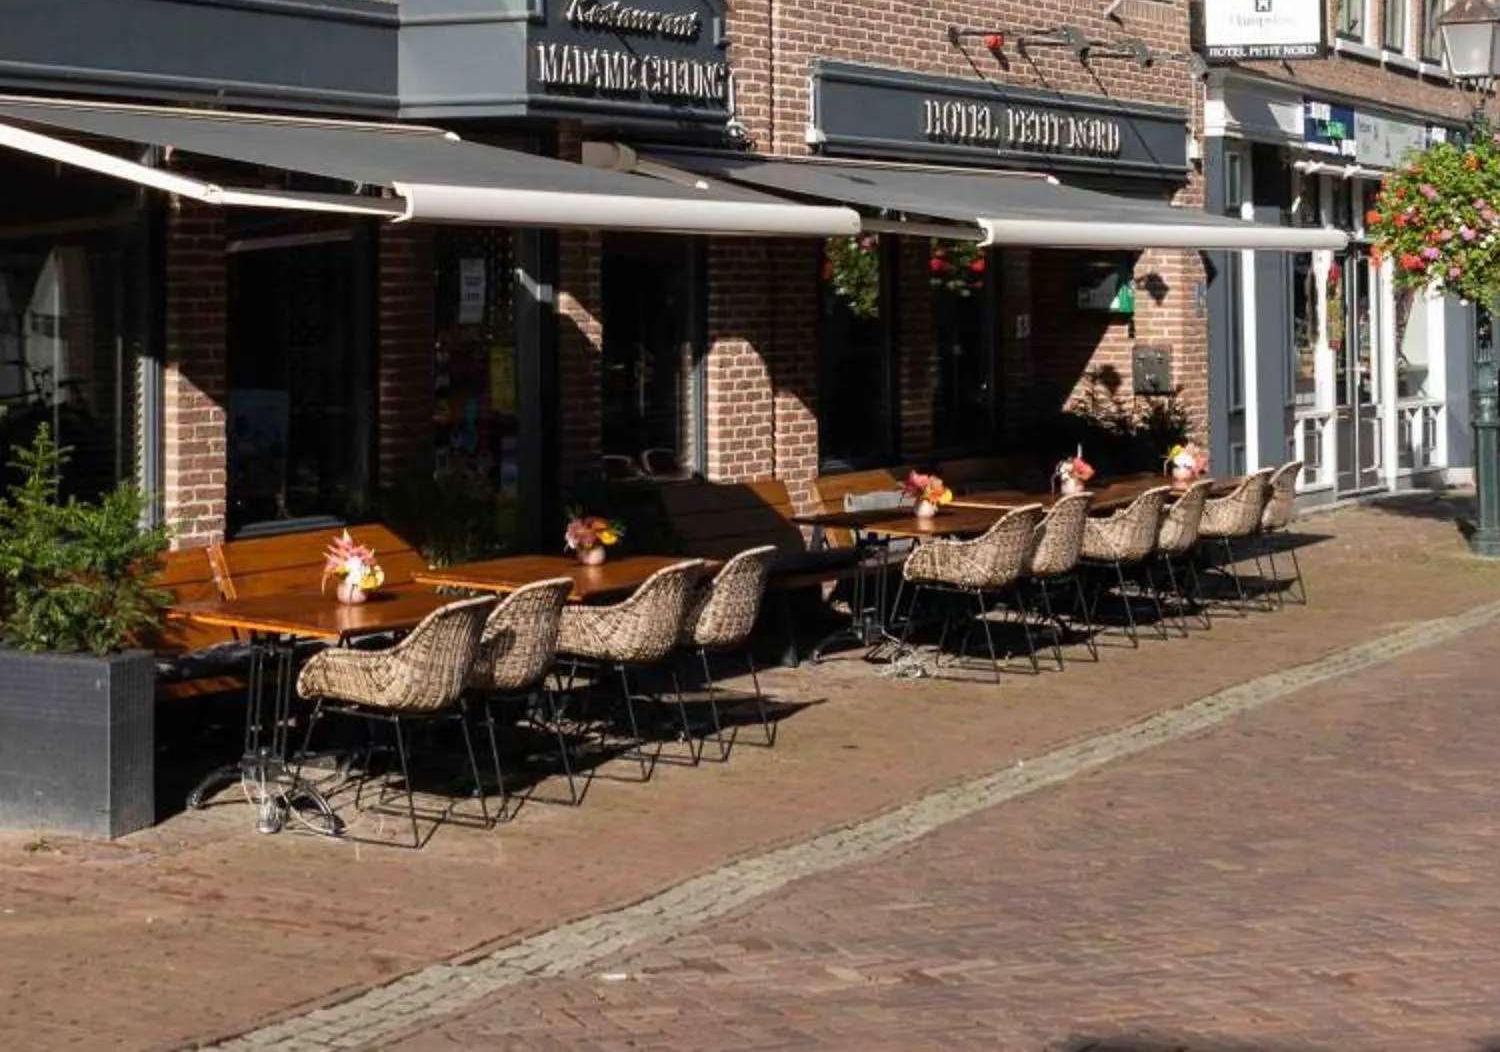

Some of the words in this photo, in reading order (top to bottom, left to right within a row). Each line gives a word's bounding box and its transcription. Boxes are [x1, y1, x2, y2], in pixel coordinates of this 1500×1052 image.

[537, 42, 638, 90] MADAME
[1209, 46, 1247, 57] HOTEL
[1249, 46, 1280, 57] PETIT
[1283, 44, 1317, 56] NORD
[925, 100, 999, 140] HOTEL
[1007, 107, 1064, 146] PETIT
[1066, 117, 1120, 152] NORD
